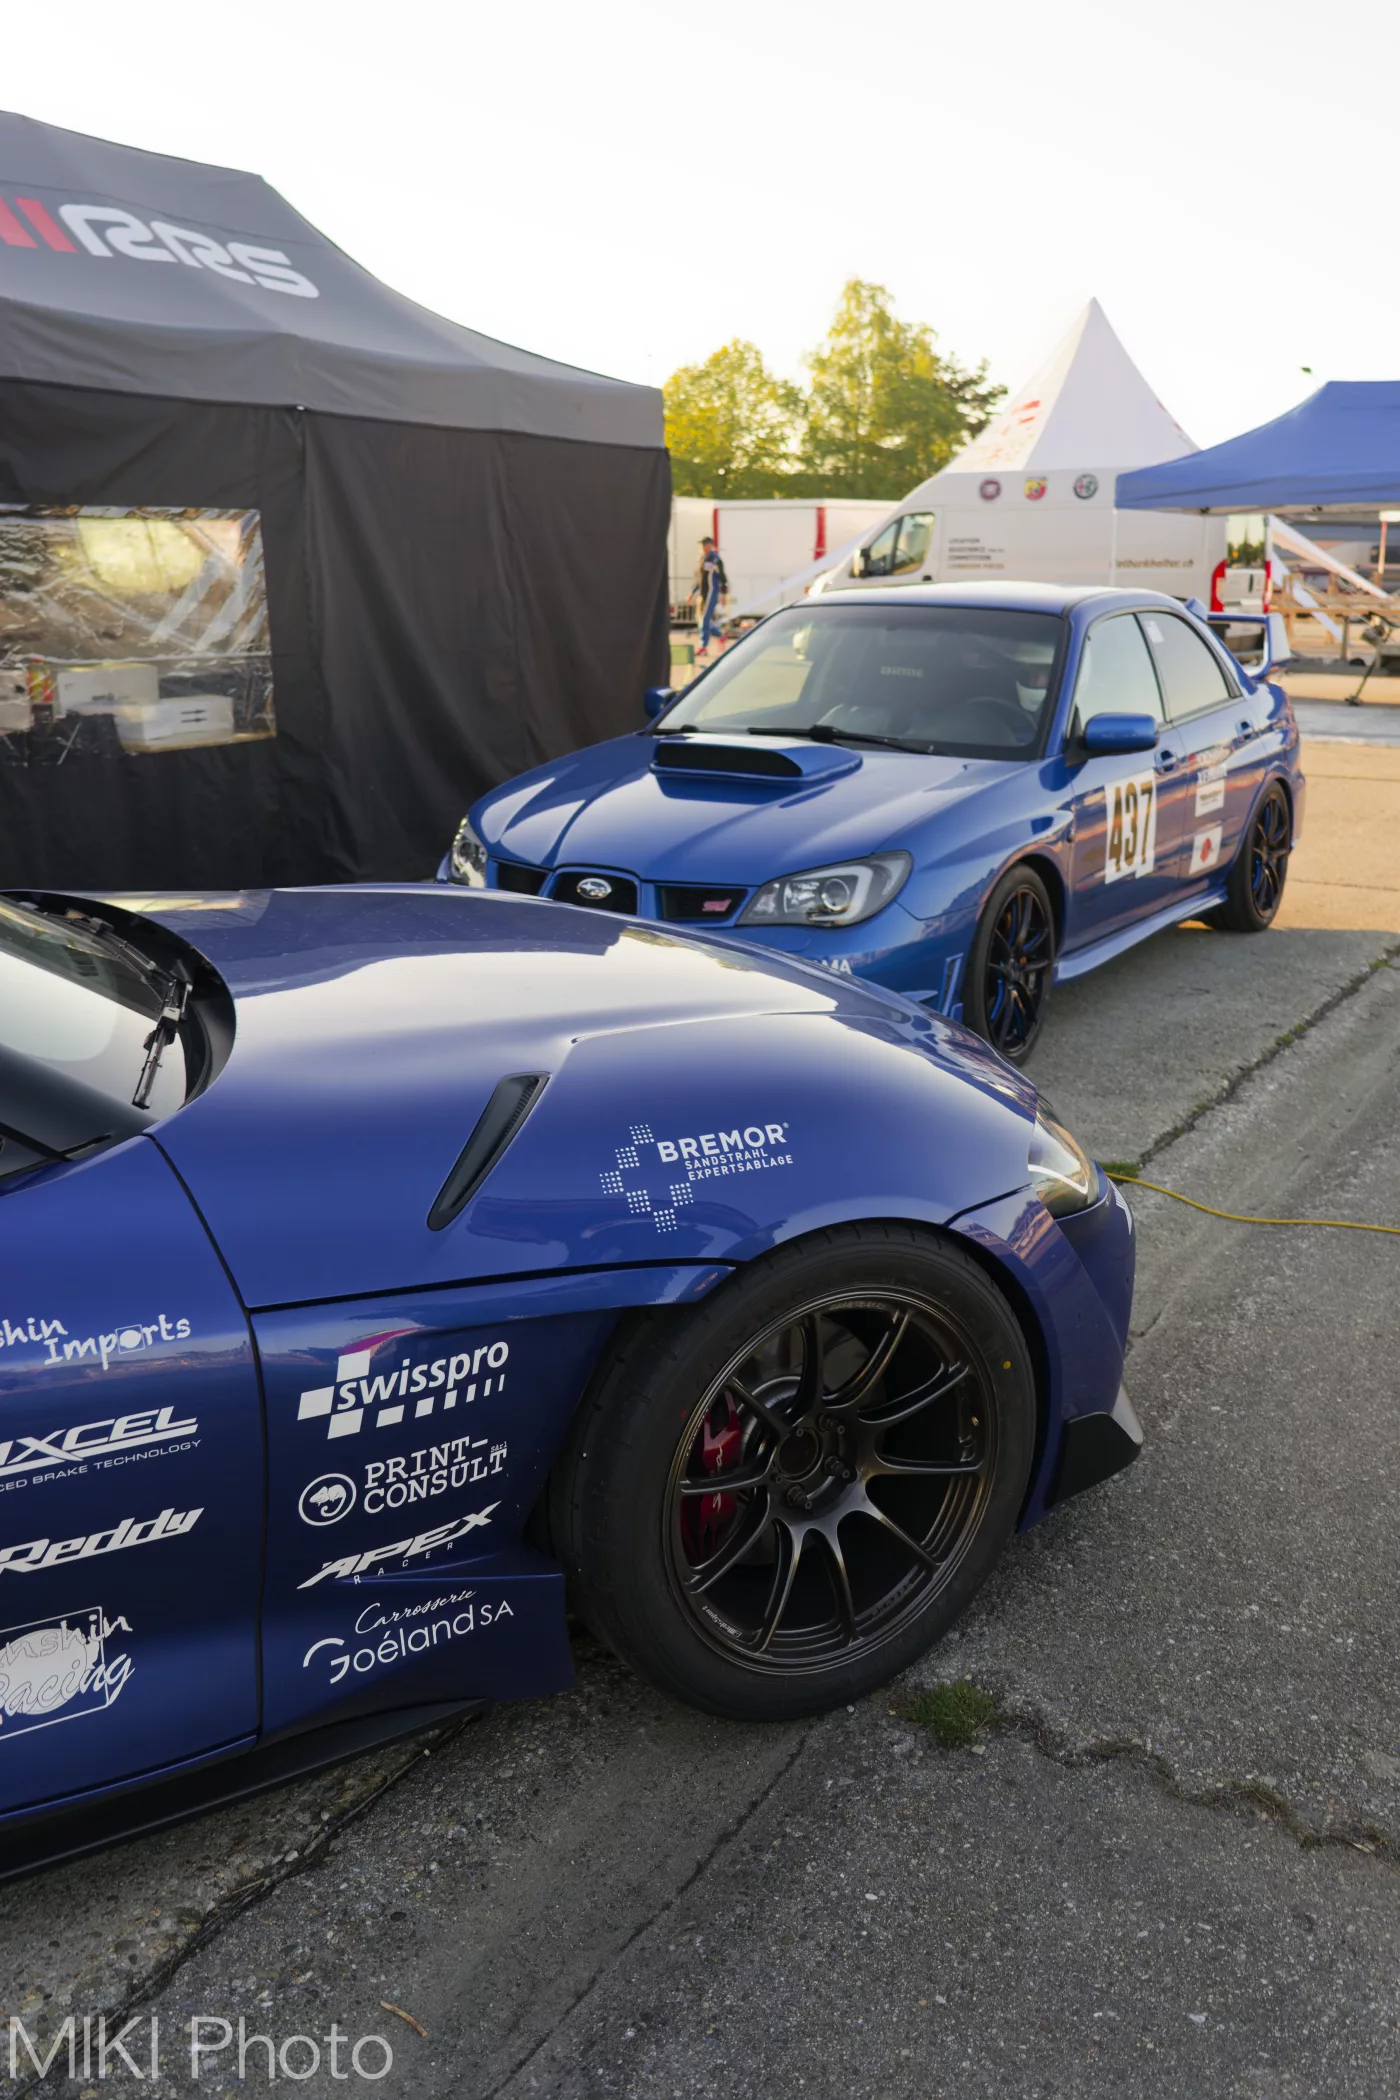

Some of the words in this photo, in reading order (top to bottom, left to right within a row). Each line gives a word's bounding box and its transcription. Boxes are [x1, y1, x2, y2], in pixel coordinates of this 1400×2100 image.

[1108, 780, 1154, 873] 437
[685, 1147, 769, 1170] SANDSTRAHL
[688, 1154, 794, 1181] EXPERTSABLAGE
[43, 1313, 192, 1371] Imports
[336, 1340, 509, 1411] swisspro
[32, 1464, 88, 1485] BRAKE
[94, 1439, 202, 1470] TECHNOLOGY
[363, 1448, 508, 1514] CONSULT
[364, 1435, 489, 1489] PRINT-
[296, 1500, 502, 1590] APEX
[355, 1589, 477, 1635] Carrosserie
[302, 1604, 475, 1684] Goéland
[480, 1599, 514, 1627] SA
